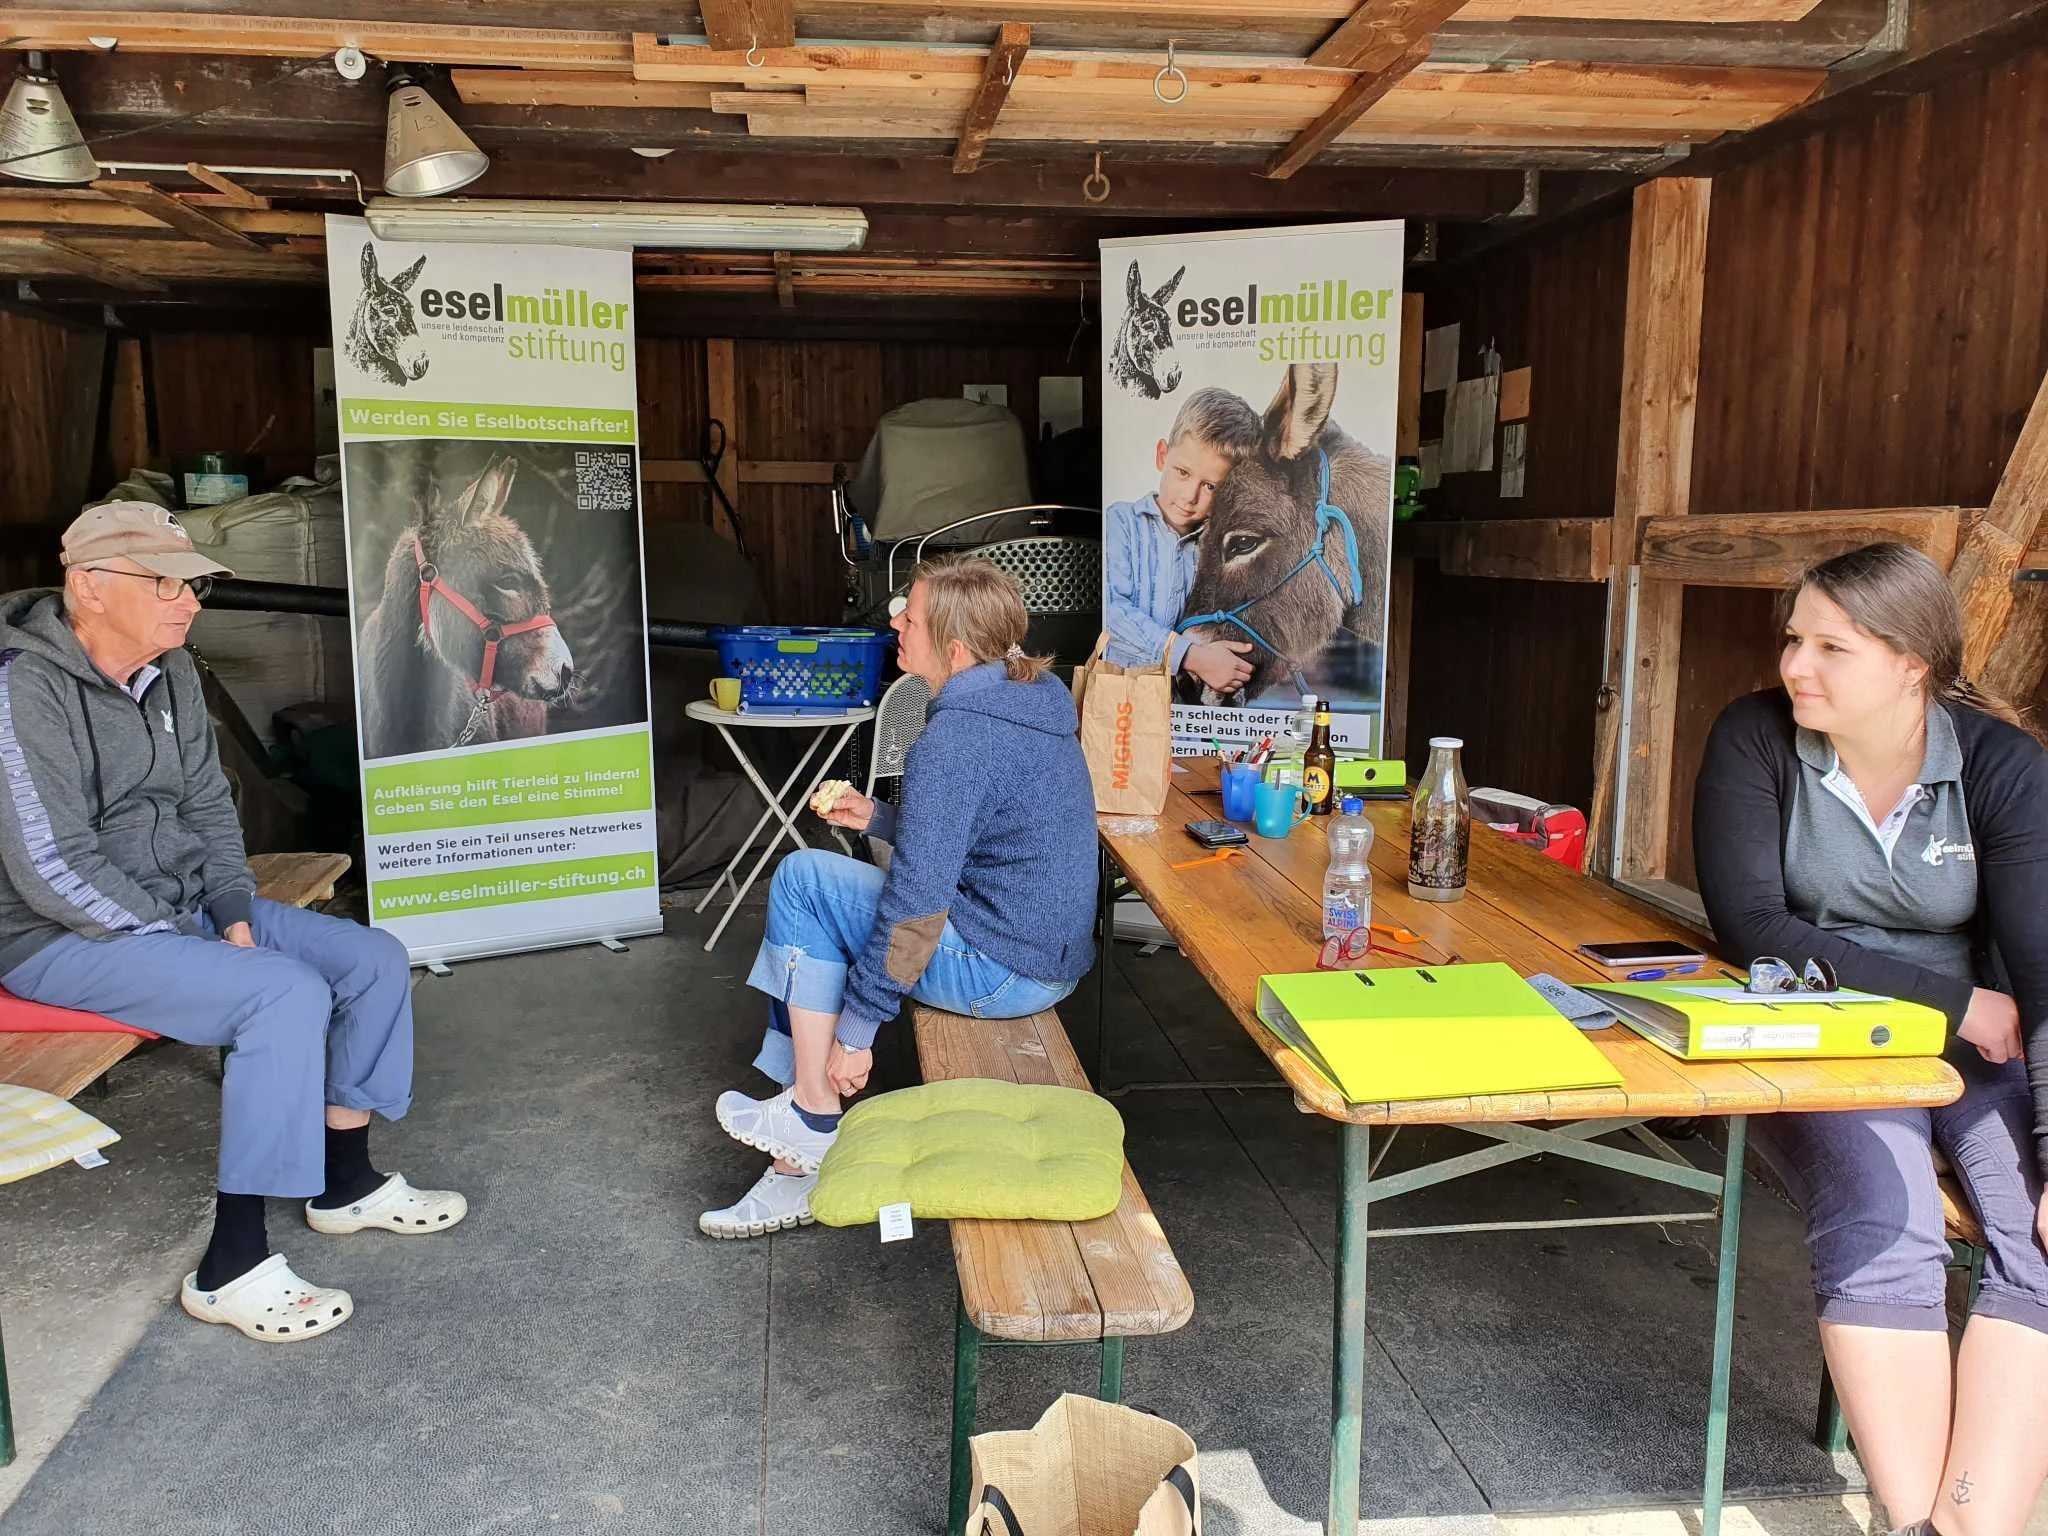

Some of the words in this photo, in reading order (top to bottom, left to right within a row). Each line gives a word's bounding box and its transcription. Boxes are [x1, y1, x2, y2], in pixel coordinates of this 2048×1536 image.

[420, 283, 629, 330] eselmüller
[1177, 279, 1394, 328] eselmüller
[421, 322, 450, 332] unsere
[452, 322, 505, 334] leidenschaft
[441, 332, 458, 341] und
[459, 332, 505, 344] kompetenz
[1176, 332, 1204, 342] unsere
[1206, 329, 1257, 341] leidenschaft
[507, 328, 626, 372] stiftung
[1195, 341, 1211, 350] und
[1212, 339, 1257, 351] kompetenz
[1258, 326, 1387, 367] stiftung
[349, 408, 431, 427] Werden
[437, 412, 469, 428] Sie
[475, 413, 629, 434] Eselbotschafter!
[1186, 723, 1212, 734] Esel
[1217, 727, 1241, 737] aus
[1245, 727, 1279, 738] ihrer
[1187, 710, 1244, 723] schlecht
[1248, 714, 1281, 725] oder
[1112, 702, 1133, 789] MIGROS
[373, 781, 462, 800] Aufklärung
[467, 778, 497, 793] hilft
[503, 774, 559, 789] Tierleid
[563, 774, 580, 785] zu
[584, 768, 640, 783] lindern!
[375, 801, 425, 816] Geben
[430, 798, 454, 811] Sie
[459, 795, 487, 808] den
[493, 791, 523, 806] Esel
[528, 790, 559, 802] eine
[564, 784, 623, 800] Stimme!
[378, 841, 432, 855] Werden
[436, 838, 457, 850] Sie
[462, 835, 482, 848] ein
[486, 833, 510, 845] Teil
[514, 829, 566, 842] unseres
[569, 821, 642, 837] Netzwerkes
[379, 855, 432, 870] weitere
[436, 845, 533, 865] Informationen
[537, 841, 577, 854] unter:
[379, 866, 646, 909] www.eselmüller-stiftung.ch
